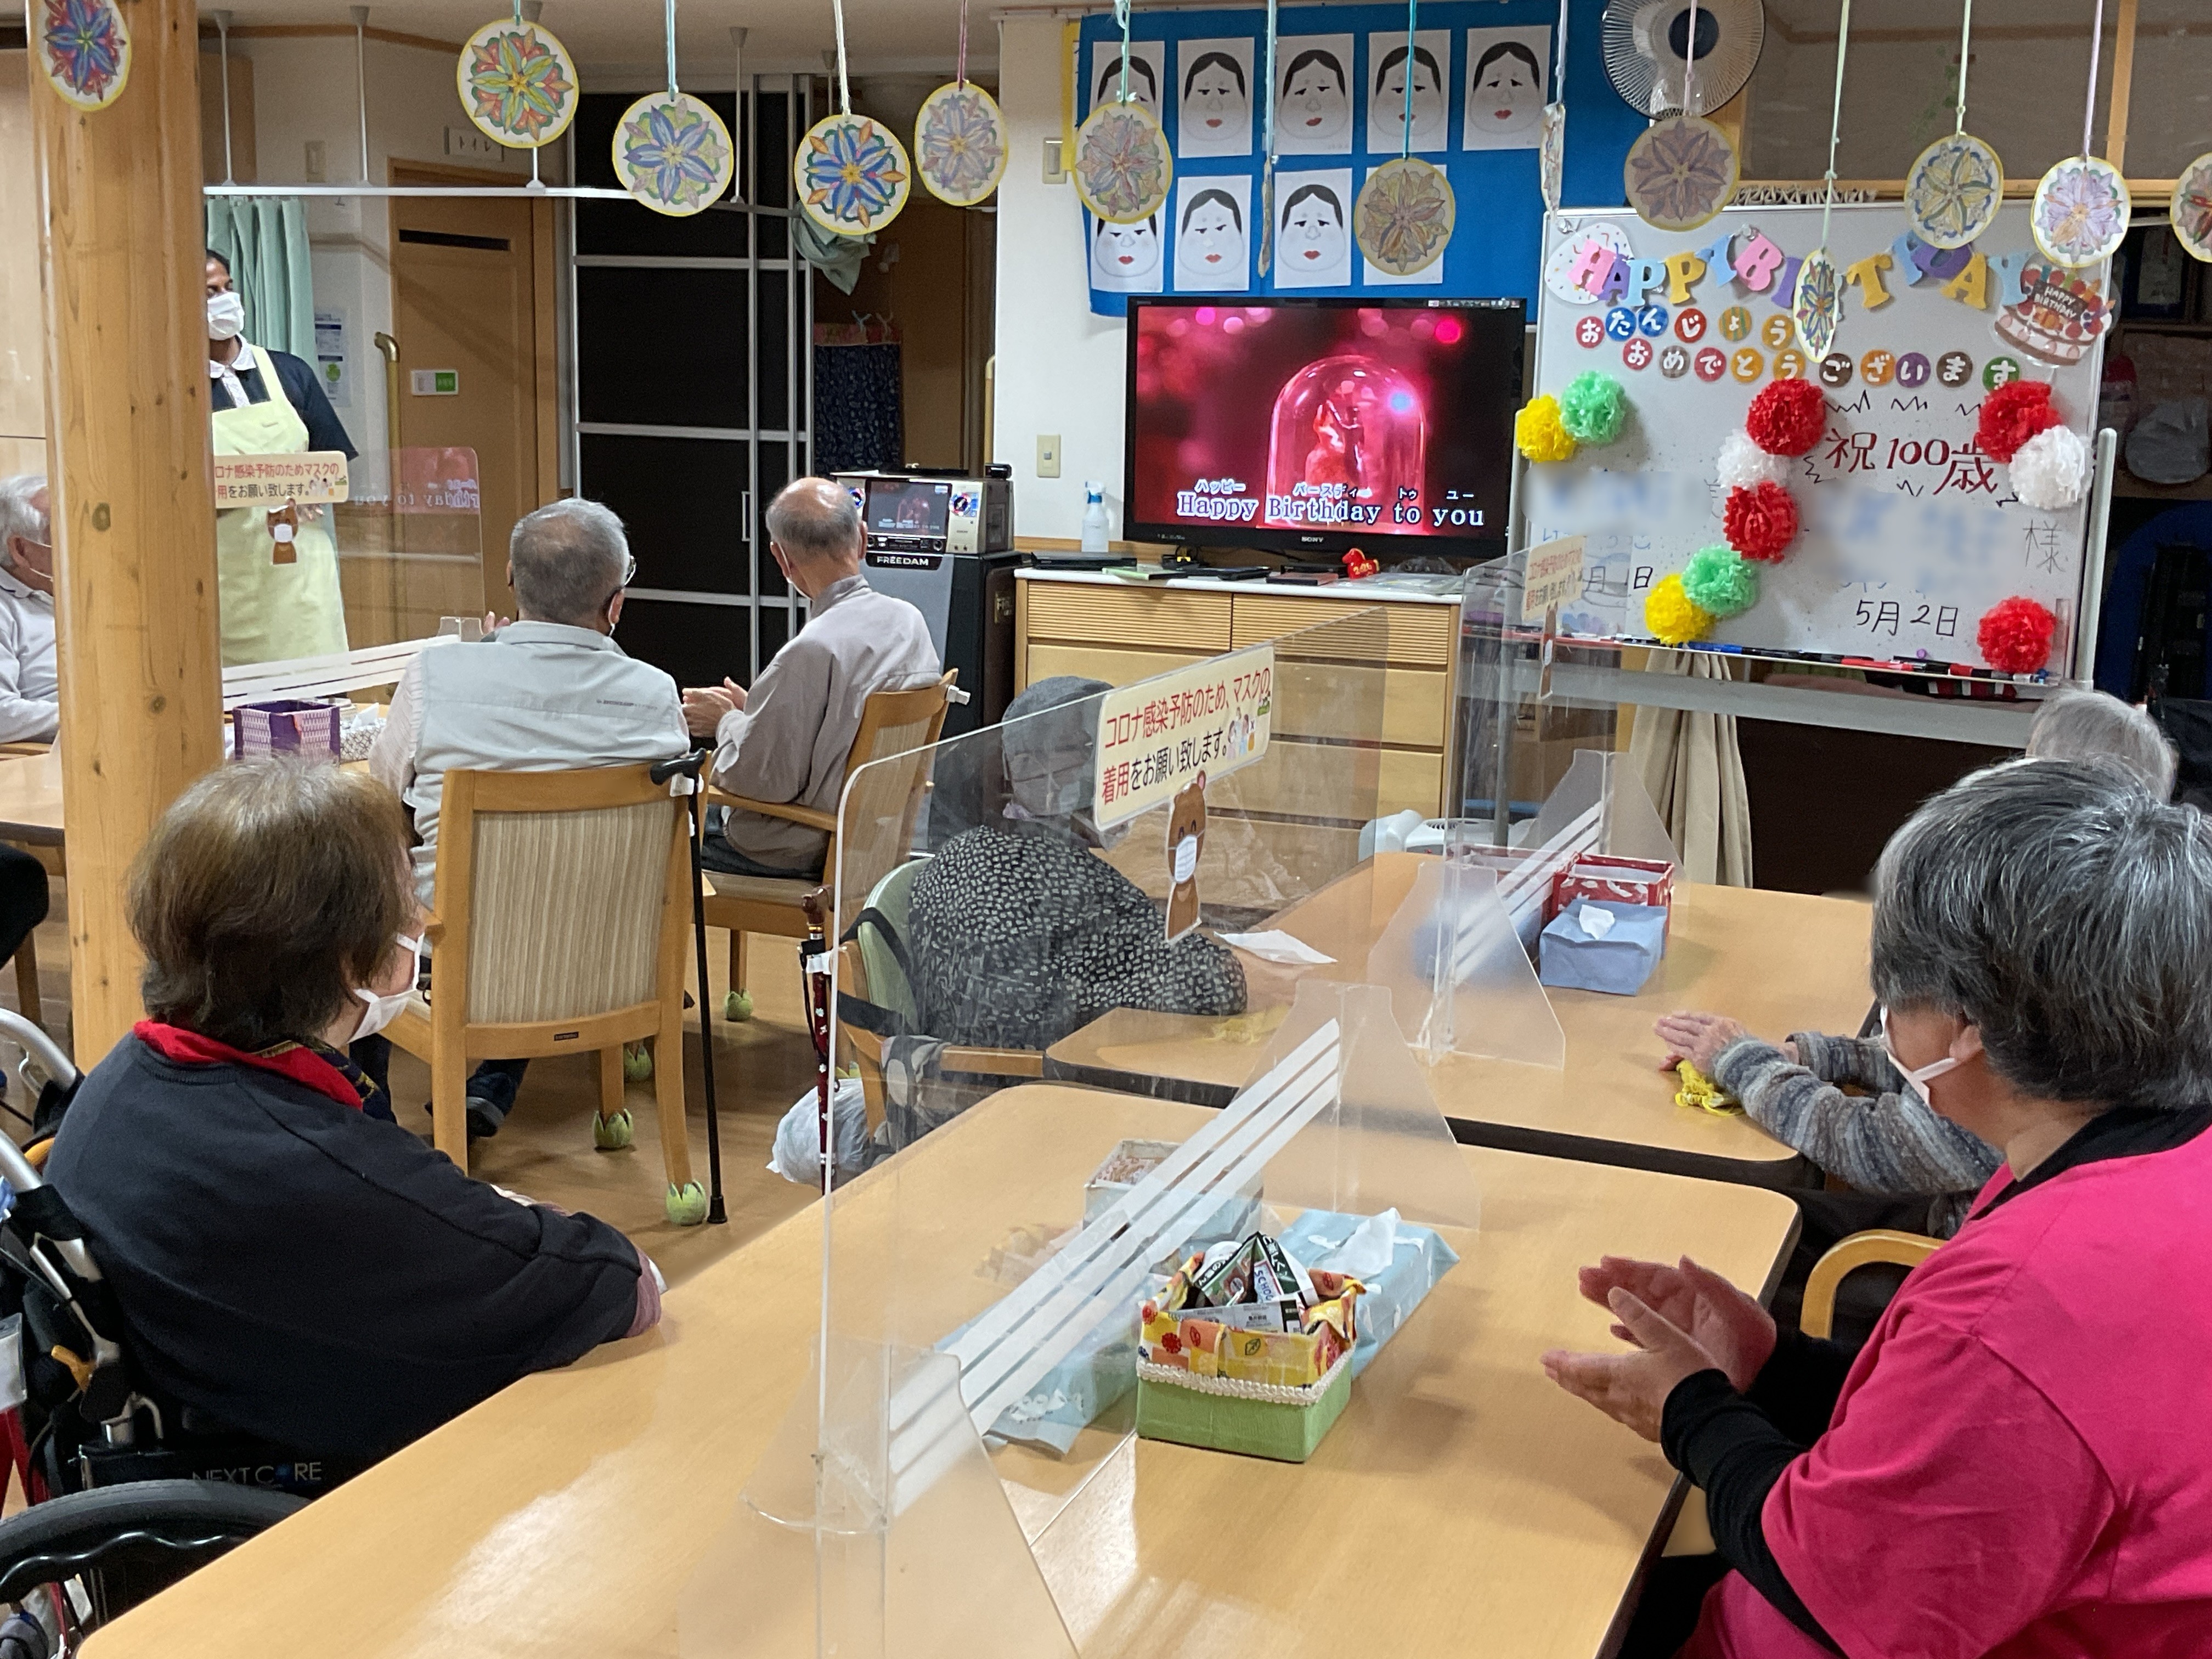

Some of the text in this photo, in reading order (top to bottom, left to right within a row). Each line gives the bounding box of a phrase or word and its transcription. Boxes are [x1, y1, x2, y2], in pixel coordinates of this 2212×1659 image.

[2034, 294, 2076, 318] BIRTHDAY
[2044, 286, 2076, 305] HAPPY
[1627, 341, 2016, 390] おめでとうございます
[215, 462, 340, 478] ロナ感染予防のためマスクの
[217, 483, 309, 500] 用をお願い致します。
[1195, 479, 1246, 494] ハッピー
[1178, 492, 1485, 527] Happy Birthday to you
[2022, 519, 2066, 575] 様
[877, 556, 929, 566] FREEDAM
[1856, 600, 1958, 636] 5月2日
[1102, 729, 1227, 805] 着用をお願い致します。
